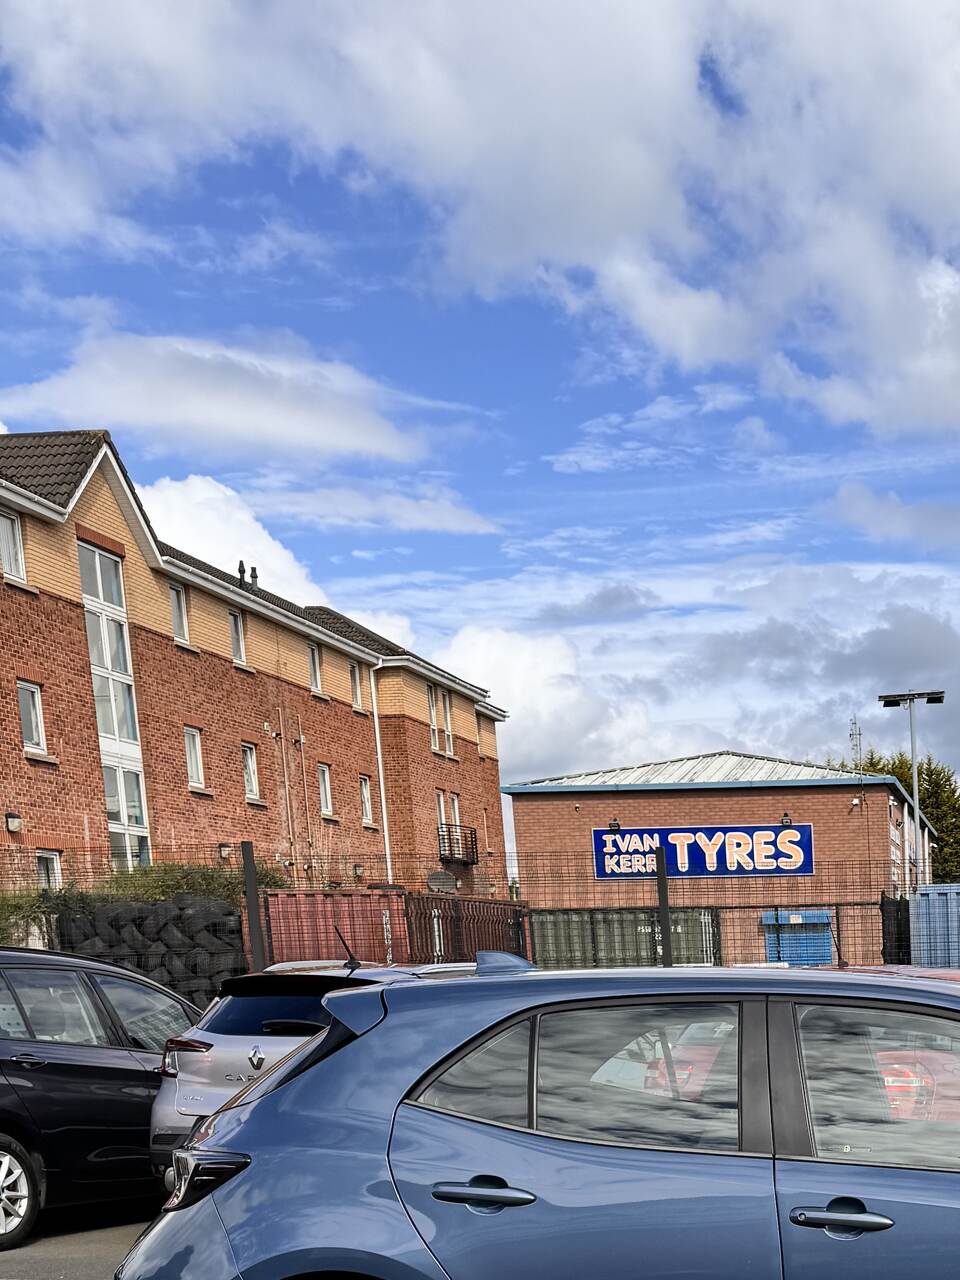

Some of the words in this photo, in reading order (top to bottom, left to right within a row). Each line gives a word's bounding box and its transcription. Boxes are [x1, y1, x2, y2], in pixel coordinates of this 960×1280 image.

[602, 833, 660, 853] IVAN
[668, 829, 804, 872] TYRES
[605, 854, 657, 874] KERR
